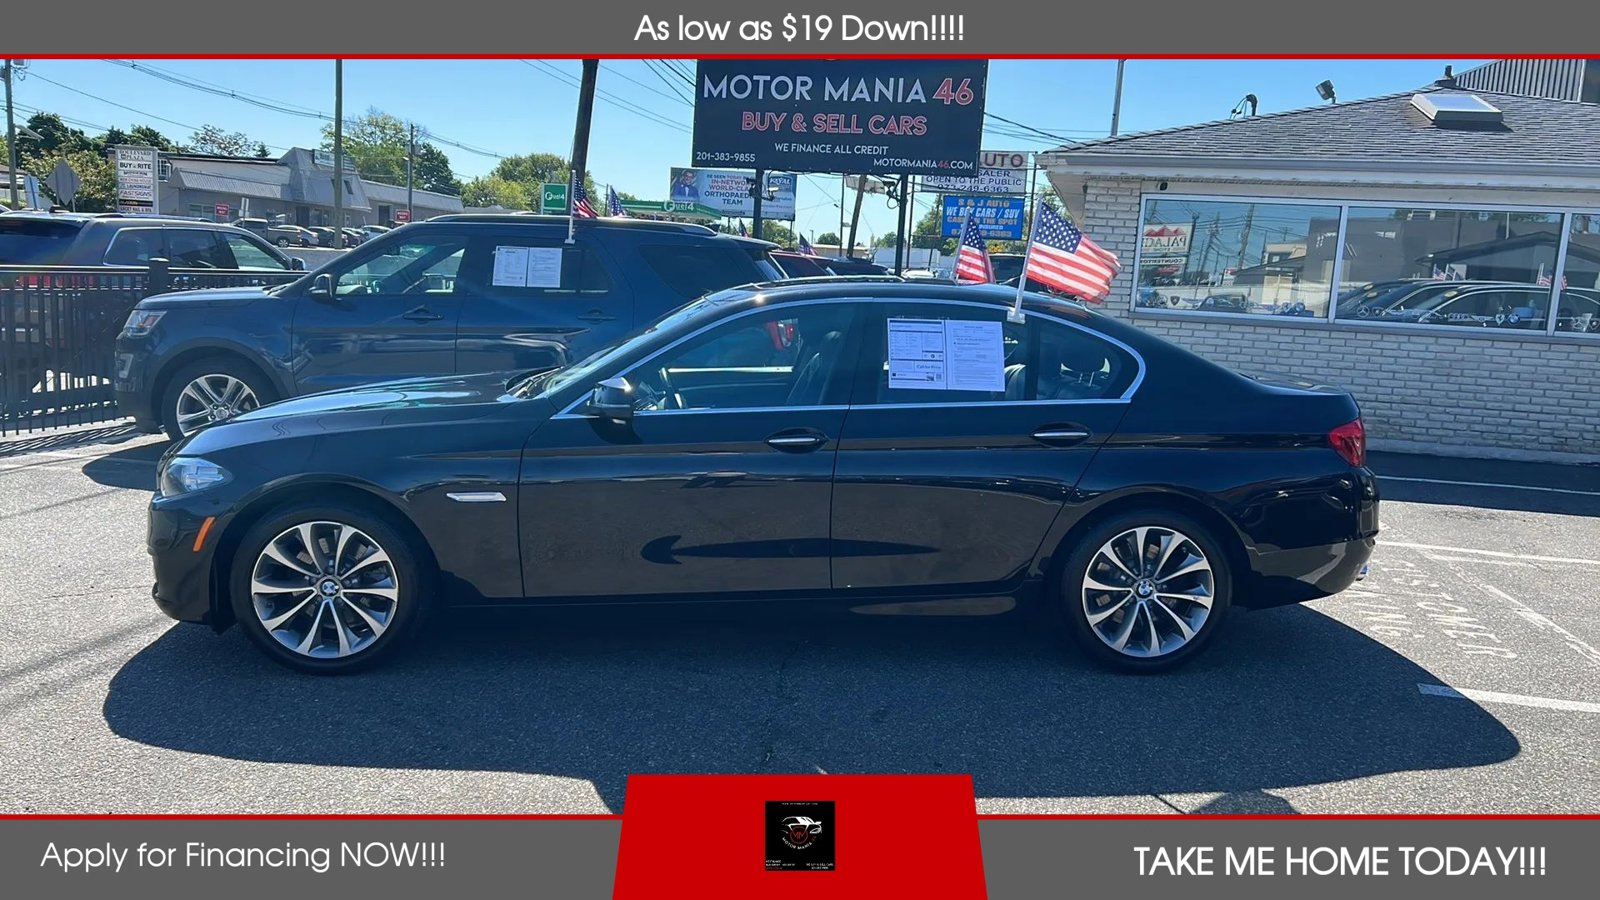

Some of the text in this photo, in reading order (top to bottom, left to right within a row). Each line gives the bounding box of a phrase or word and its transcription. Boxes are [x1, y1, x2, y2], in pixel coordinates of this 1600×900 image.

[704, 74, 974, 106] MOTOR MANIA 46
[741, 111, 928, 136] BUY & SELL CARS
[774, 142, 889, 156] WE FINANCE ALL CREDIT
[696, 151, 756, 162] 201-383-9855
[979, 153, 1023, 168] UTO
[873, 158, 974, 170] MOTORMANIA46.COM
[969, 177, 985, 185] THE
[989, 178, 1022, 186] PUBLIC
[704, 190, 751, 199] ORTHOPAED
[722, 198, 743, 206] TEAM
[986, 200, 1009, 208] AUTO
[946, 206, 957, 216] WE
[975, 207, 996, 218] CARS
[1003, 209, 1020, 219] SUV
